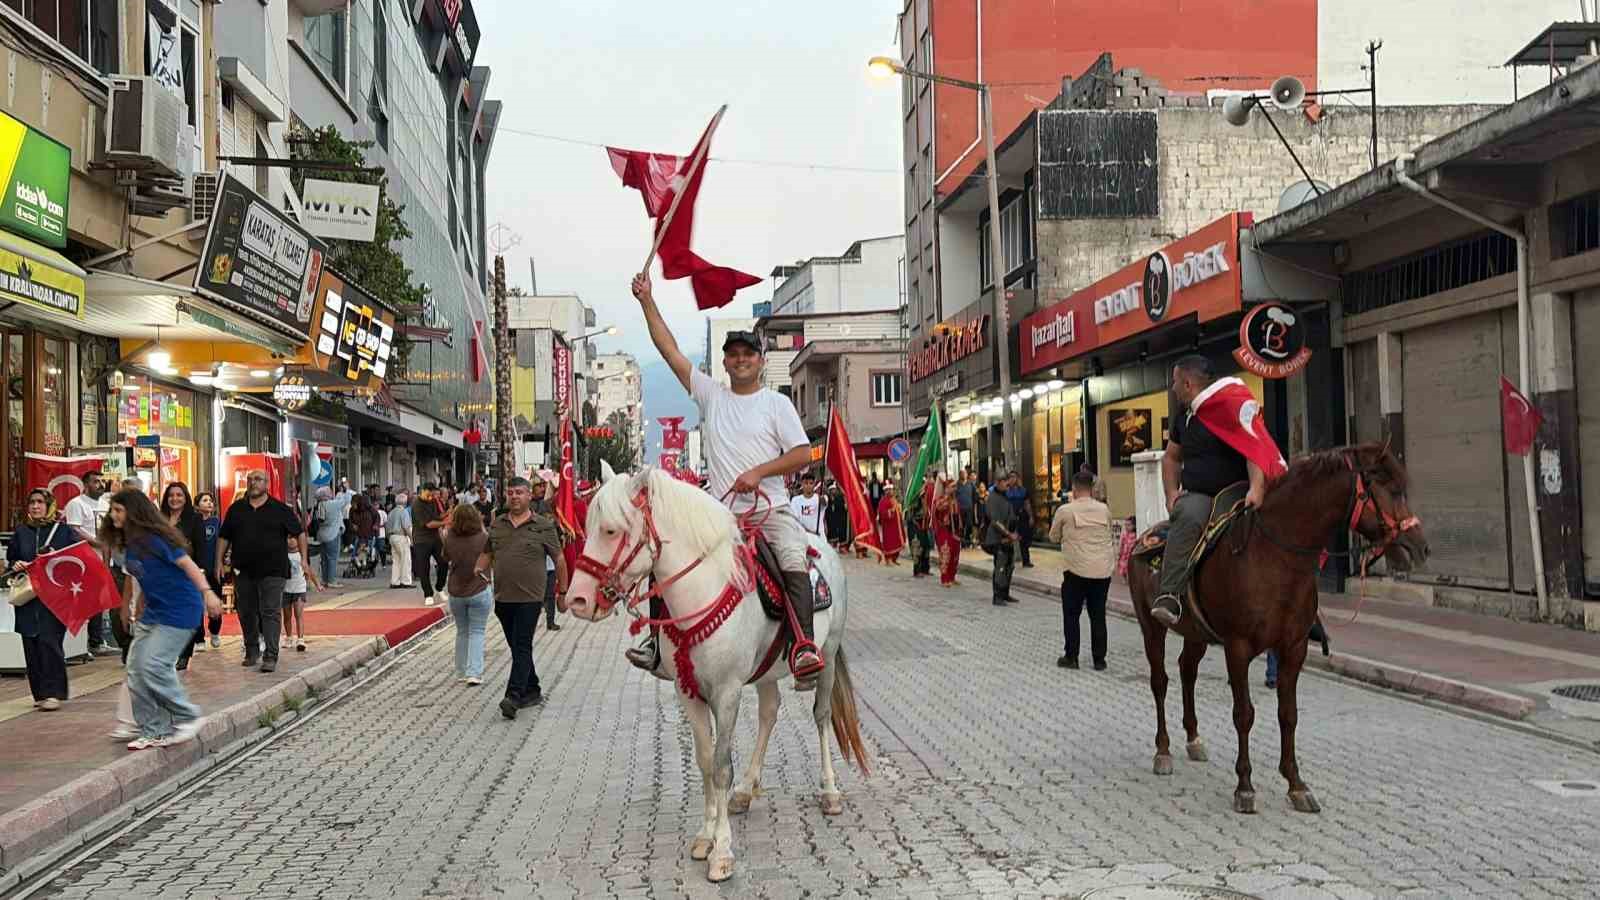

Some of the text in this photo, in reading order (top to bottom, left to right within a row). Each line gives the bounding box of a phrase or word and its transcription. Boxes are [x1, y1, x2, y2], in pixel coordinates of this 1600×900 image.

[305, 194, 371, 217] MYK
[283, 234, 305, 267] TİCARET
[1173, 241, 1230, 292] BÖREK
